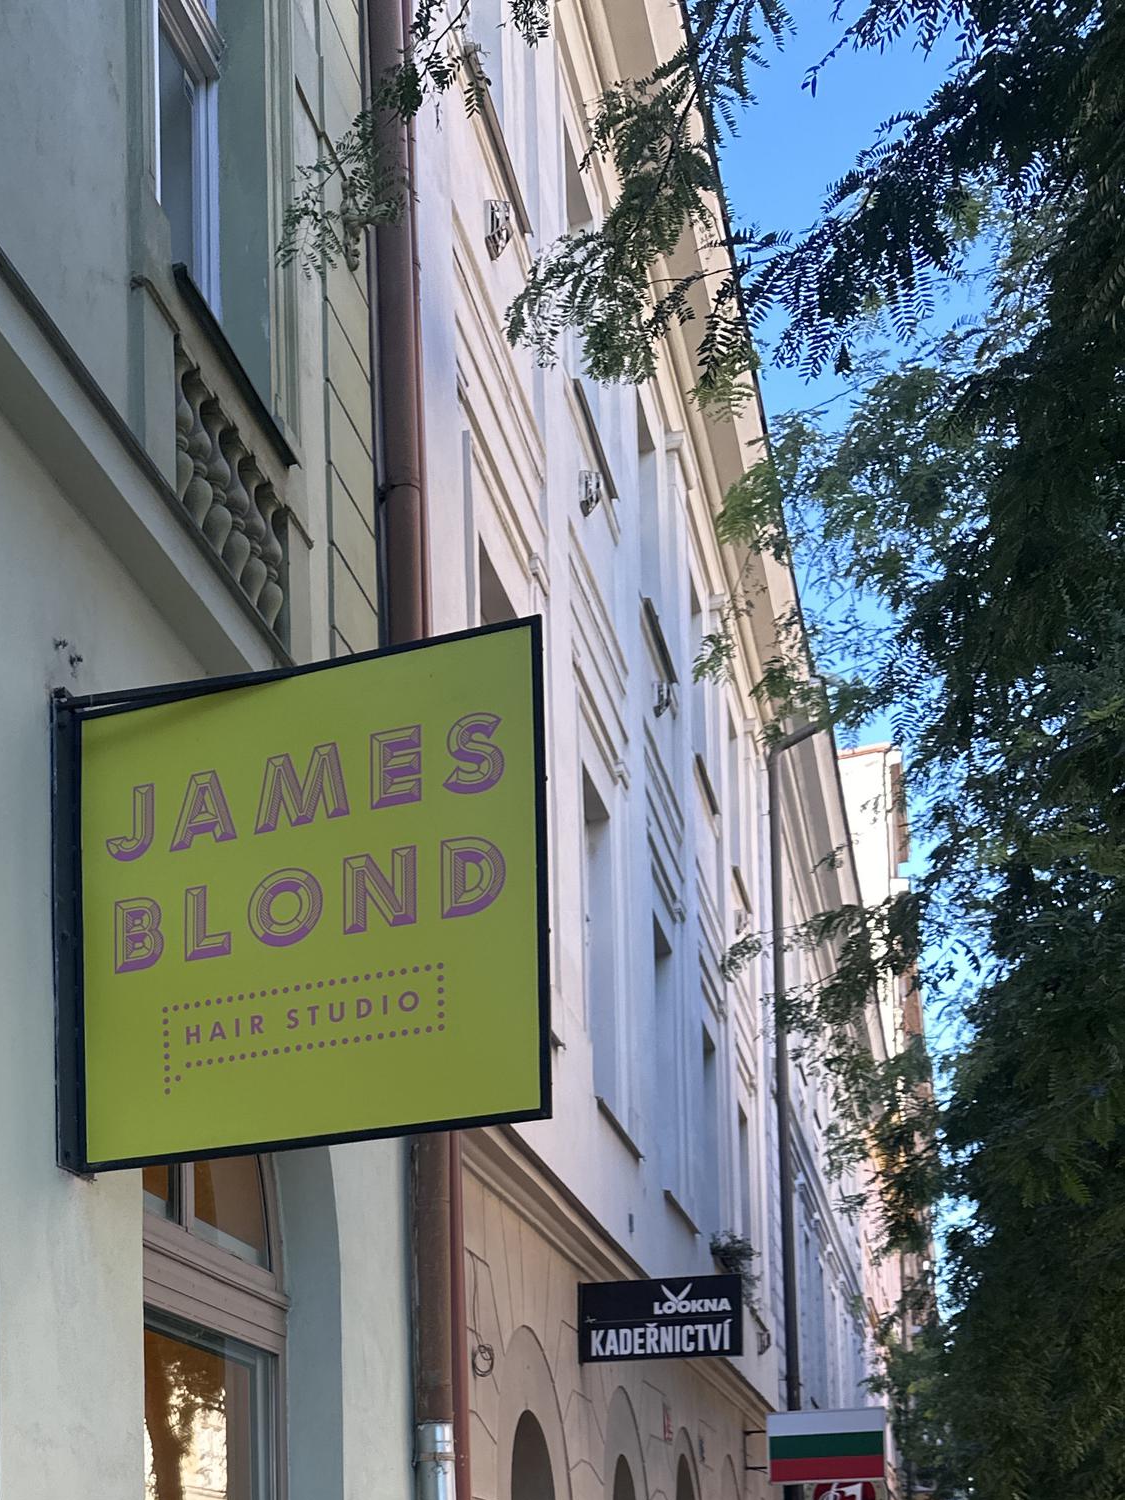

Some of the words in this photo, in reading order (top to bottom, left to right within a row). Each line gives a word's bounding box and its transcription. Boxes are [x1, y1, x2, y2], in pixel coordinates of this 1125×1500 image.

[106, 712, 505, 861] JAMES
[114, 836, 506, 974] BLOND
[185, 1015, 264, 1046] HAIR
[286, 991, 421, 1030] STUDIO
[653, 1298, 732, 1315] LOOKNA
[590, 1319, 733, 1357] KADEŘNICTVÍ
